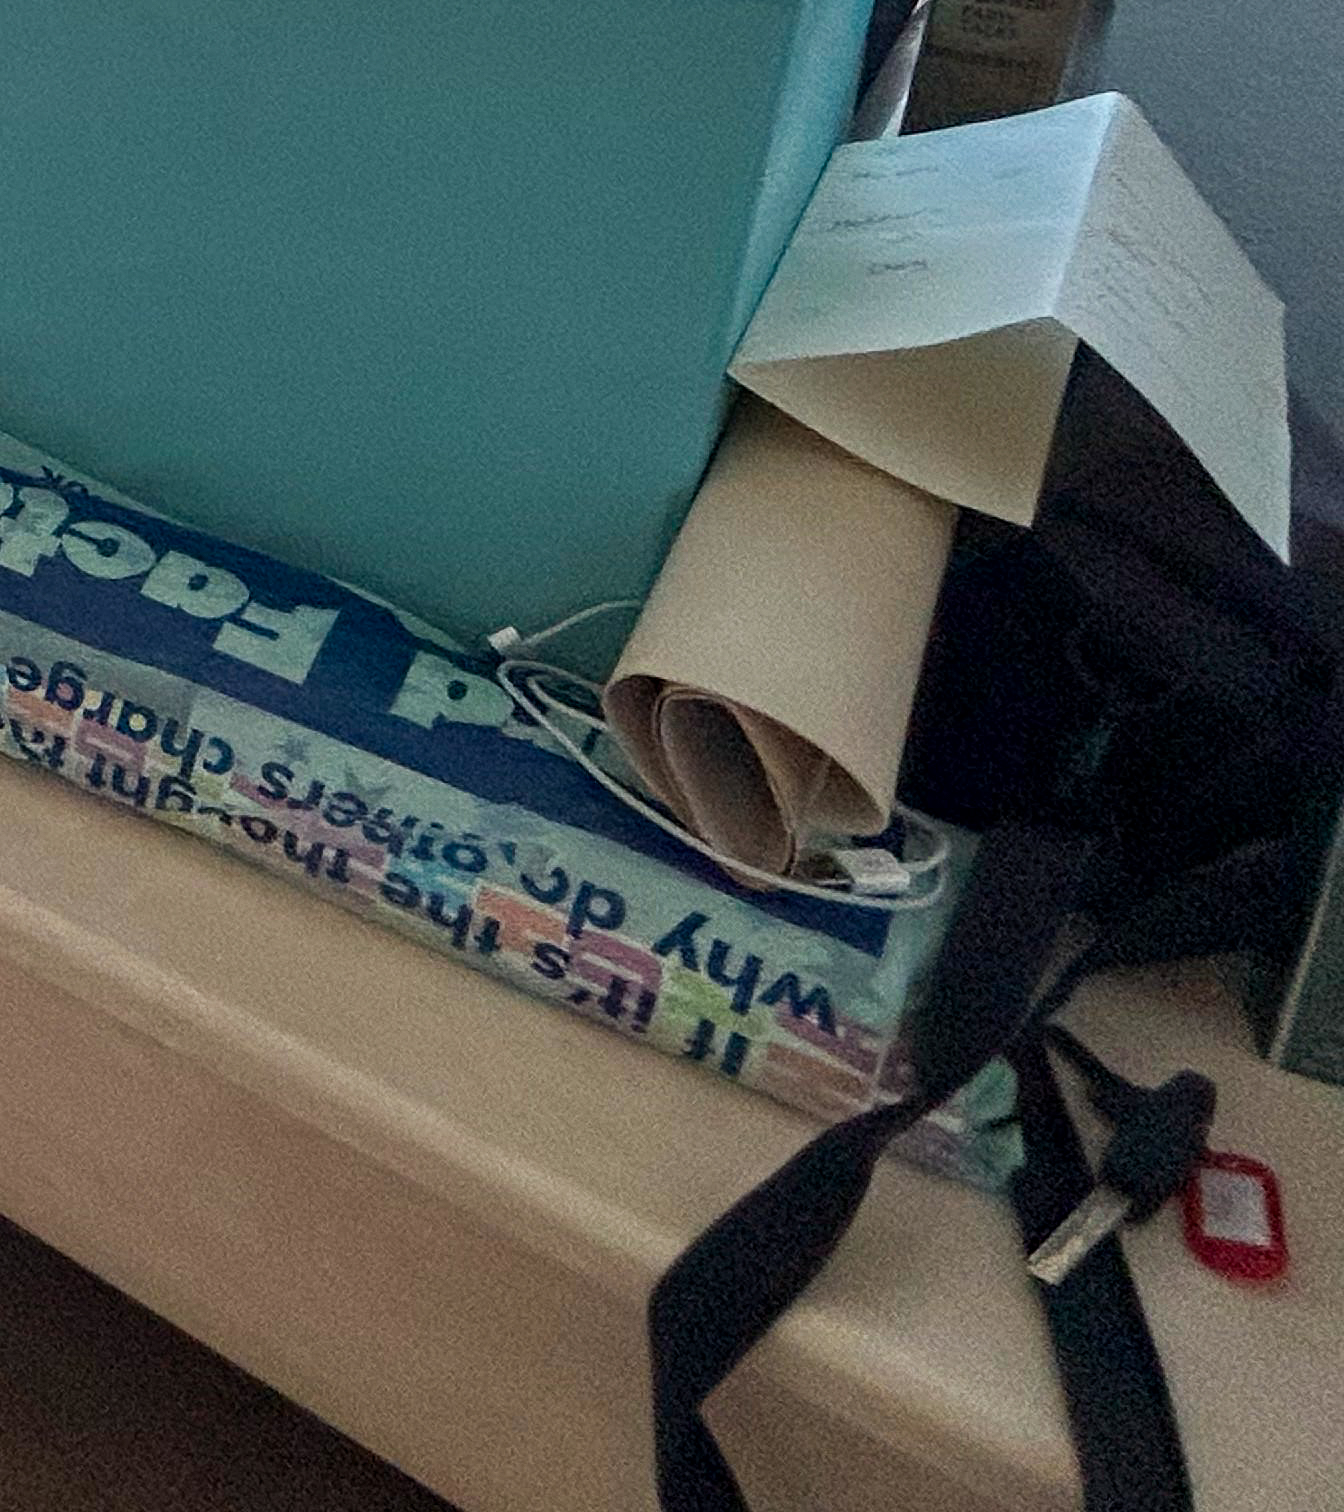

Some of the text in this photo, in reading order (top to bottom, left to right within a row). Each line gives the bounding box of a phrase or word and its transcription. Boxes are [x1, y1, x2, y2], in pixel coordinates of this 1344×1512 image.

[4, 655, 236, 783] charge
[258, 760, 490, 874] others
[379, 871, 502, 954] the
[532, 941, 658, 1033] it's
[652, 910, 840, 1037] why
[683, 1019, 752, 1076] If
